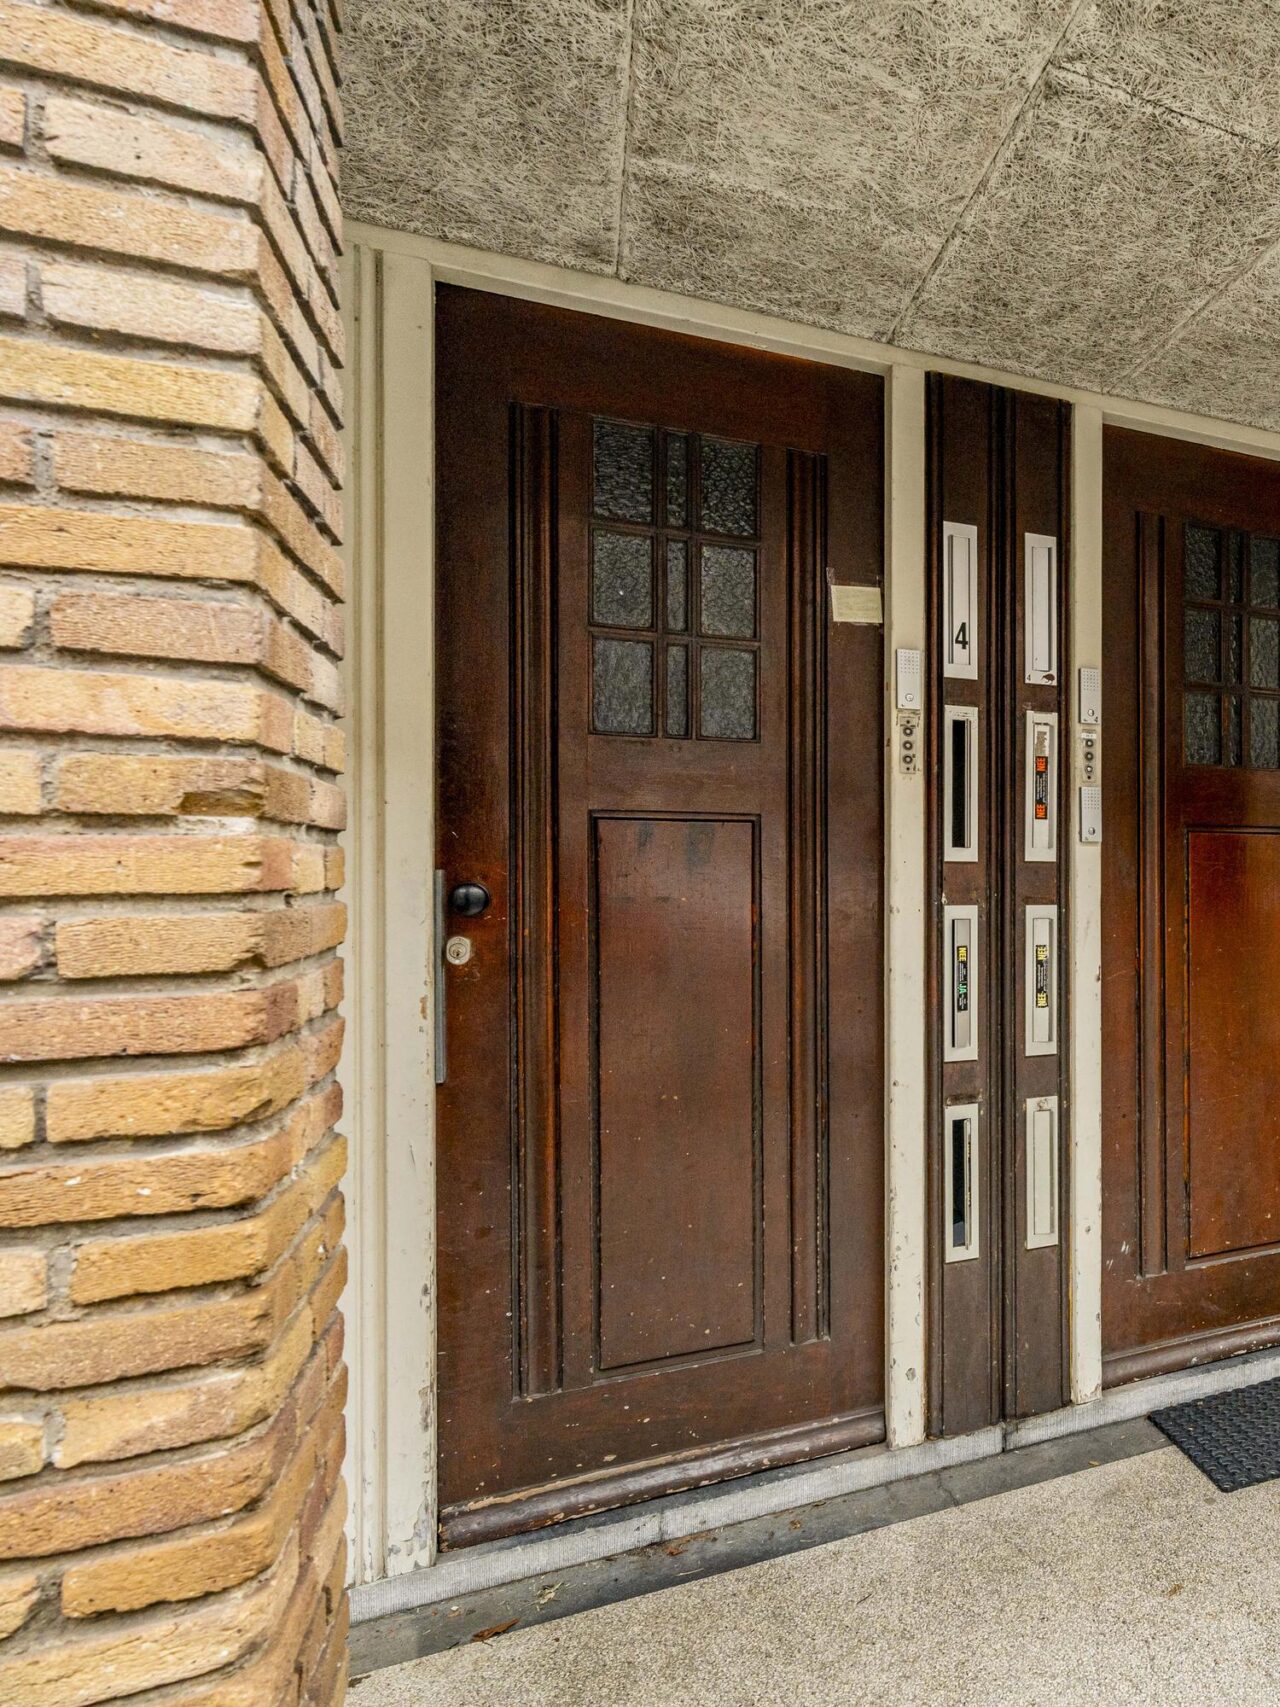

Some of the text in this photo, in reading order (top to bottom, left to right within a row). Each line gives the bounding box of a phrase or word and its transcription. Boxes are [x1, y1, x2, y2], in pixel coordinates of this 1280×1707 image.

[955, 622, 968, 650] 4
[1026, 673, 1031, 681] 4
[1036, 757, 1046, 772] NEE
[1036, 804, 1046, 818] NEE
[958, 947, 967, 962] NEE
[1037, 946, 1047, 961] NEE
[958, 983, 967, 994] JA
[1037, 992, 1047, 1007] NEE
